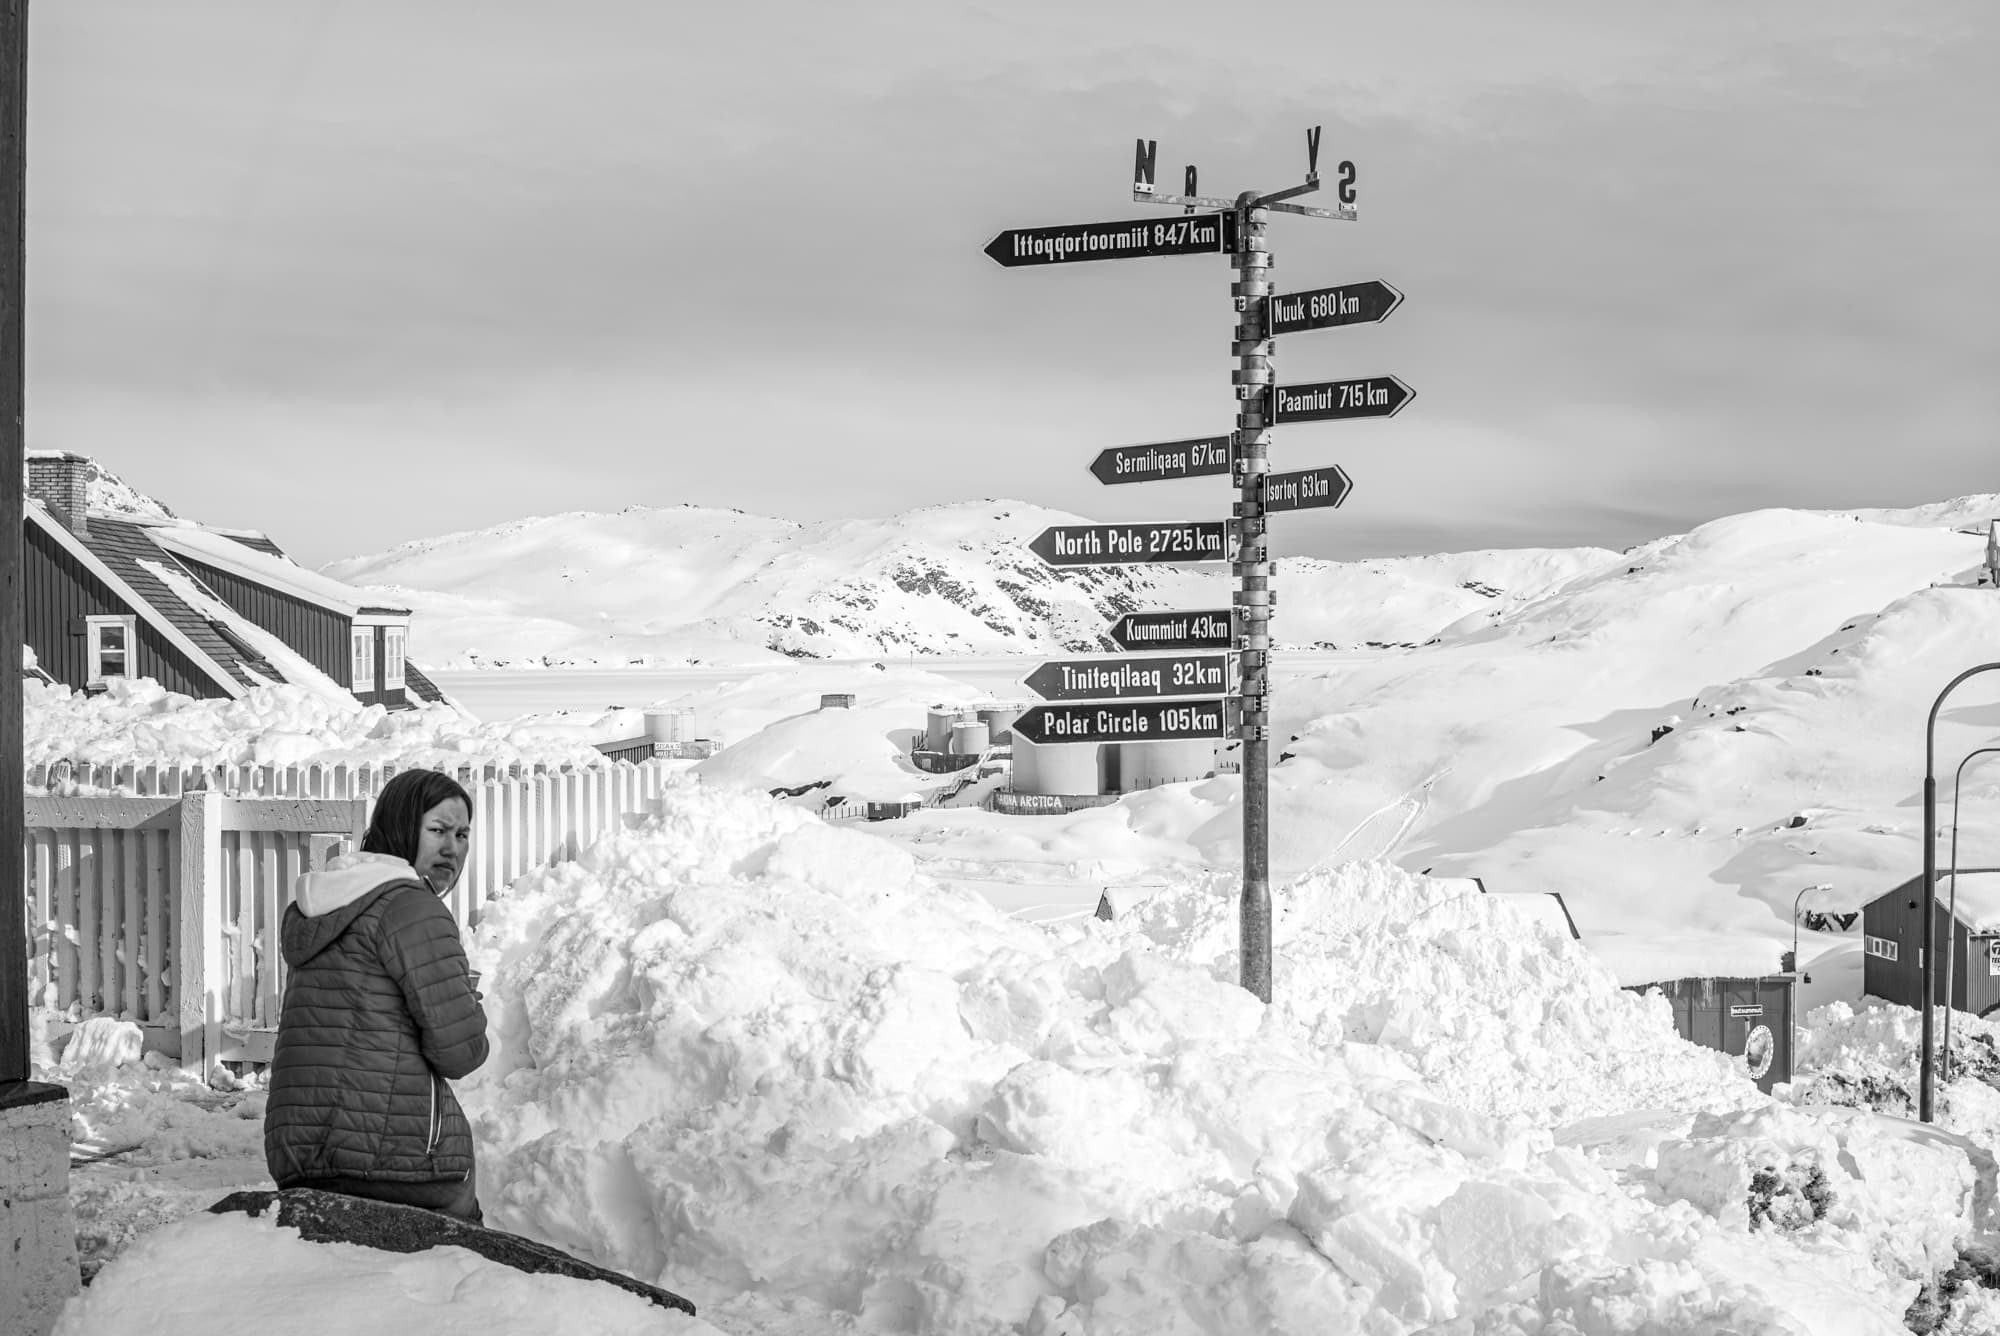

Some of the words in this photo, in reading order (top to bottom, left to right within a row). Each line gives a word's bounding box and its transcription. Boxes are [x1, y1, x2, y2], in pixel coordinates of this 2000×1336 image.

[1134, 139, 1157, 184] N
[1014, 228, 1148, 261] Ittoqqortoormiit
[1275, 298, 1305, 323] Nuuk
[1278, 388, 1332, 412] Paamiut
[1116, 449, 1186, 475] Sermiliqaaq
[1267, 478, 1297, 505] Isortoq
[1055, 530, 1101, 555] North
[1108, 529, 1142, 553] Pole
[1126, 618, 1187, 641] Kuummiut
[1062, 664, 1161, 695] Tiniteqilaaq
[1044, 711, 1089, 735] Polar
[1097, 709, 1149, 733] Circle
[1020, 795, 1062, 808] ARCTICA
